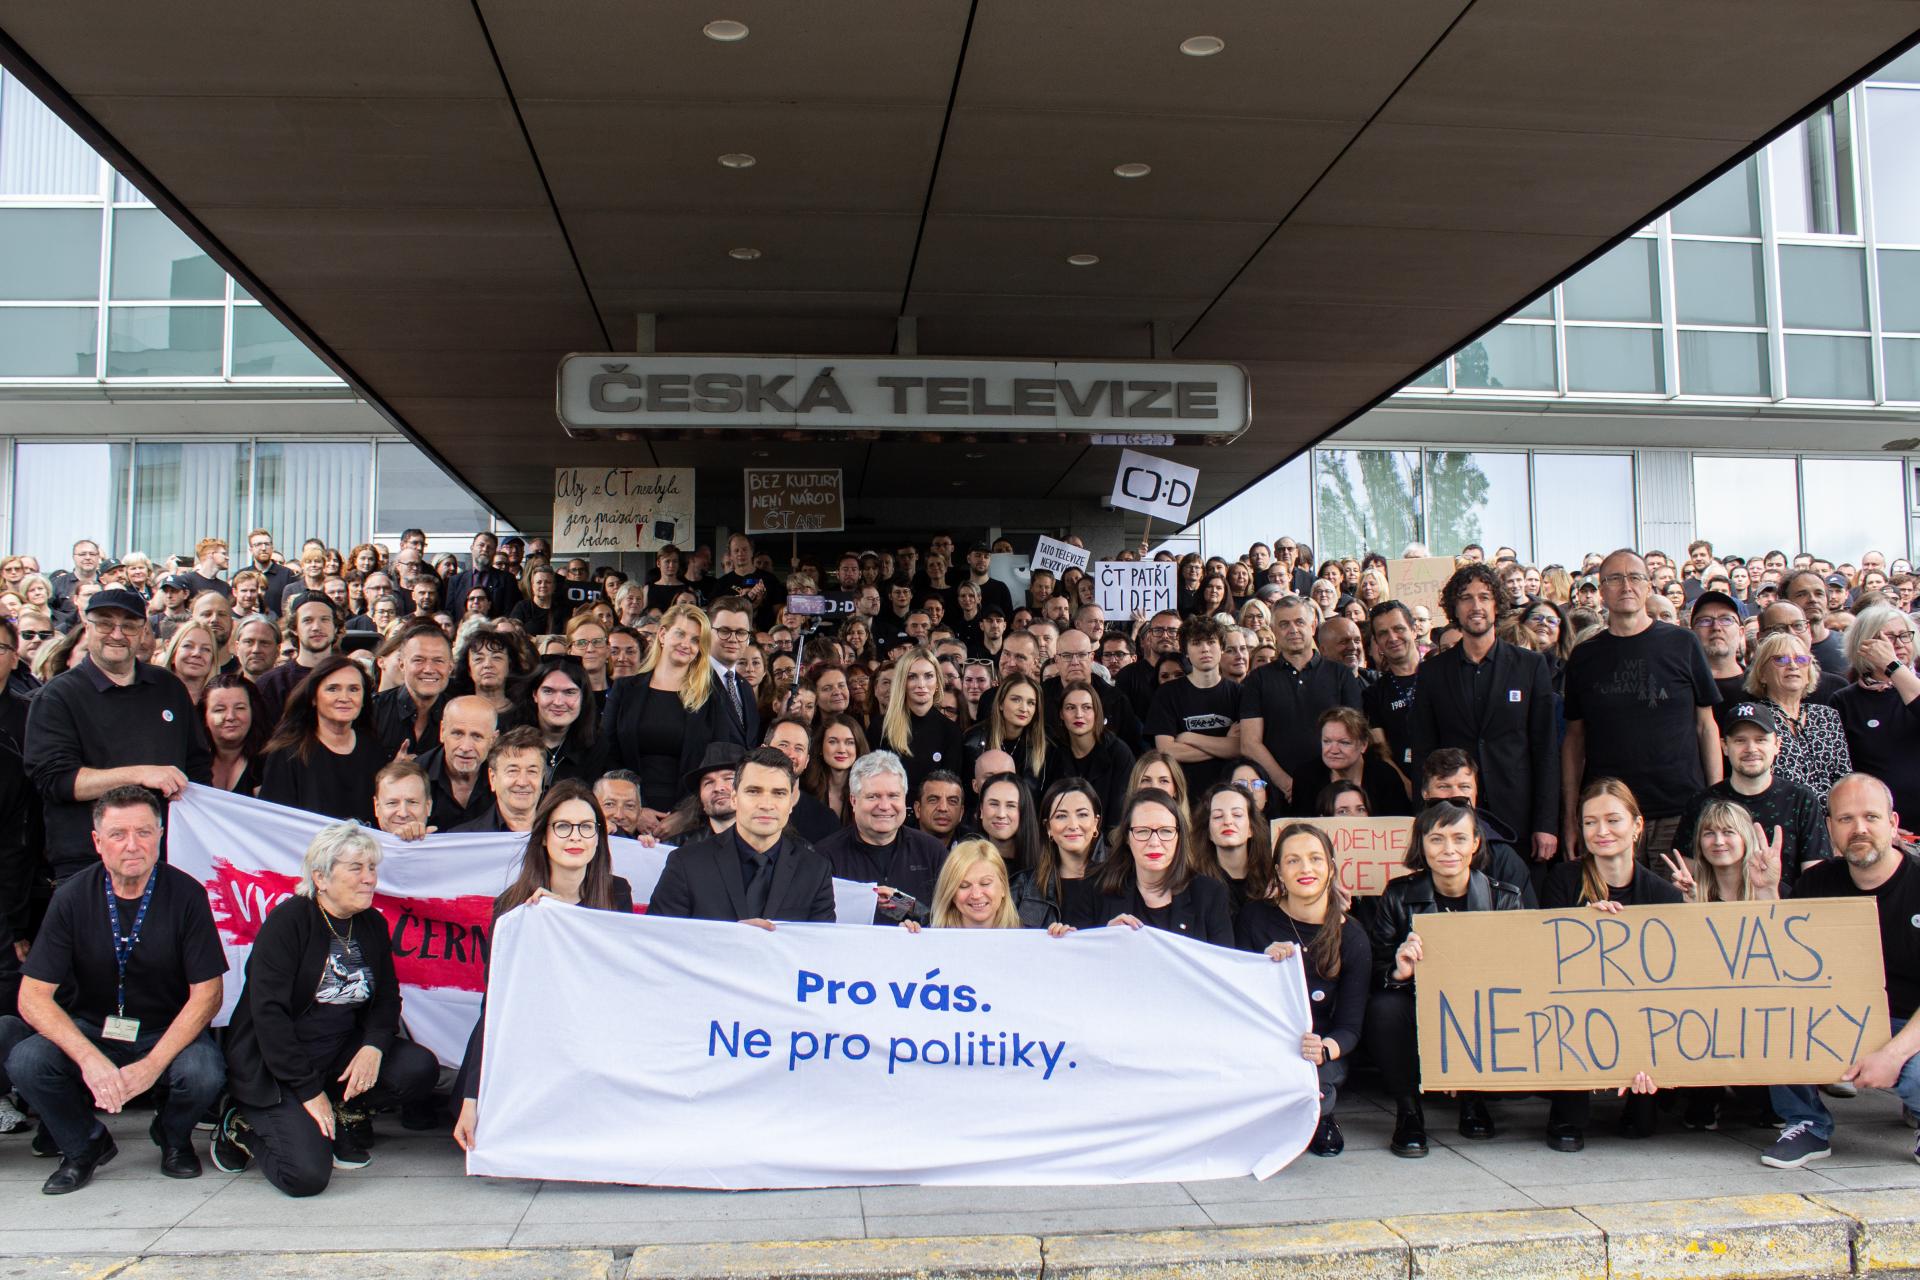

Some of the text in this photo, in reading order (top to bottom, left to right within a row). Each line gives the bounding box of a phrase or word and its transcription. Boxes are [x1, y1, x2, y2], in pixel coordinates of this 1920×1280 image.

[589, 363, 1218, 418] ČESKÁ TELEVIZE
[557, 470, 587, 506] Aby
[605, 467, 633, 496] ČT
[750, 473, 840, 490] BEZ KULTURY
[752, 488, 836, 508] NENÍ NÁROD
[563, 507, 653, 536] jen prázdná
[794, 513, 826, 529] ART
[577, 526, 620, 548] bedna
[1040, 542, 1086, 567] TATO TELEVIZE
[1101, 564, 1172, 587] ČT PATŘÍ
[1104, 589, 1170, 611] LIDEM
[1542, 904, 1832, 986] PRO VÁS.
[797, 967, 992, 1012] Pro vás.
[1638, 1005, 1872, 1067] POLITIKY
[708, 1020, 1077, 1080] Ne pro politiky.
